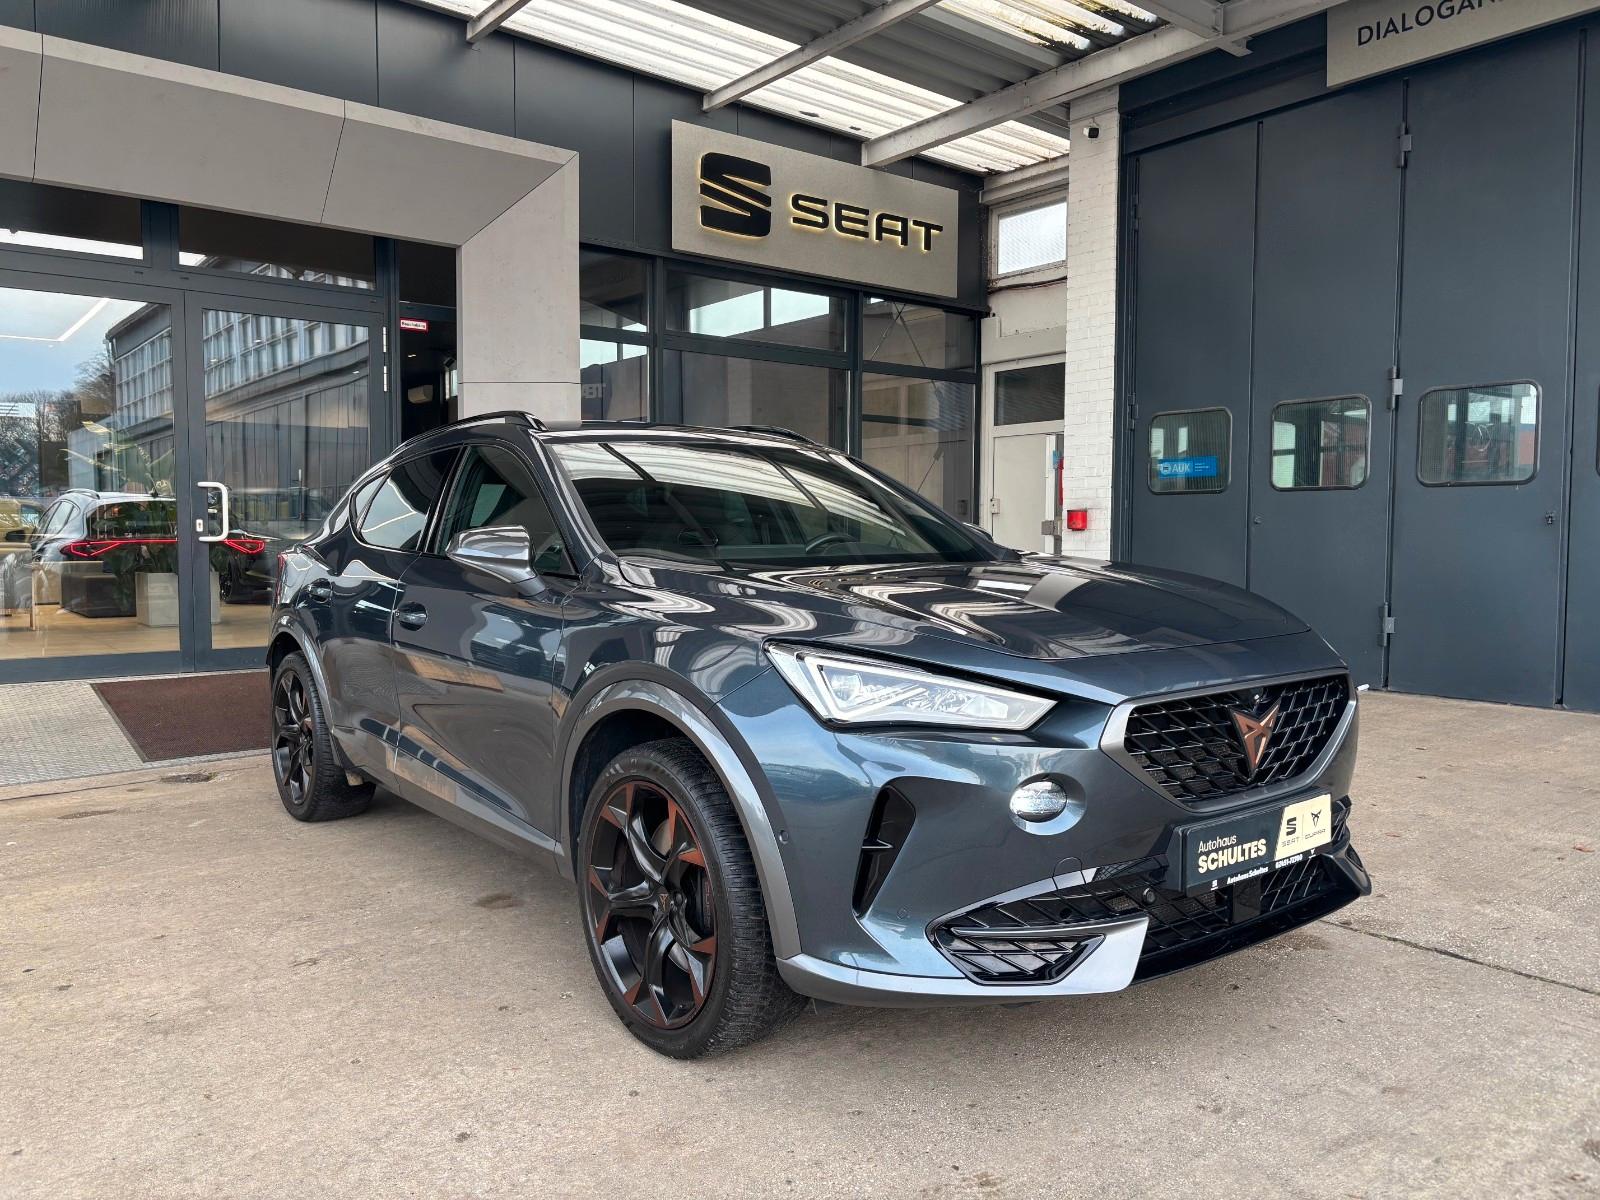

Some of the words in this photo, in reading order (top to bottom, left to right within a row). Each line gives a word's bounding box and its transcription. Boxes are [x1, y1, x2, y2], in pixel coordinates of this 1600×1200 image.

[791, 193, 944, 251] SEAT
[1198, 835, 1237, 853] Autohaus
[1281, 836, 1300, 847] SEAT
[1198, 839, 1267, 874] SCHULTES
